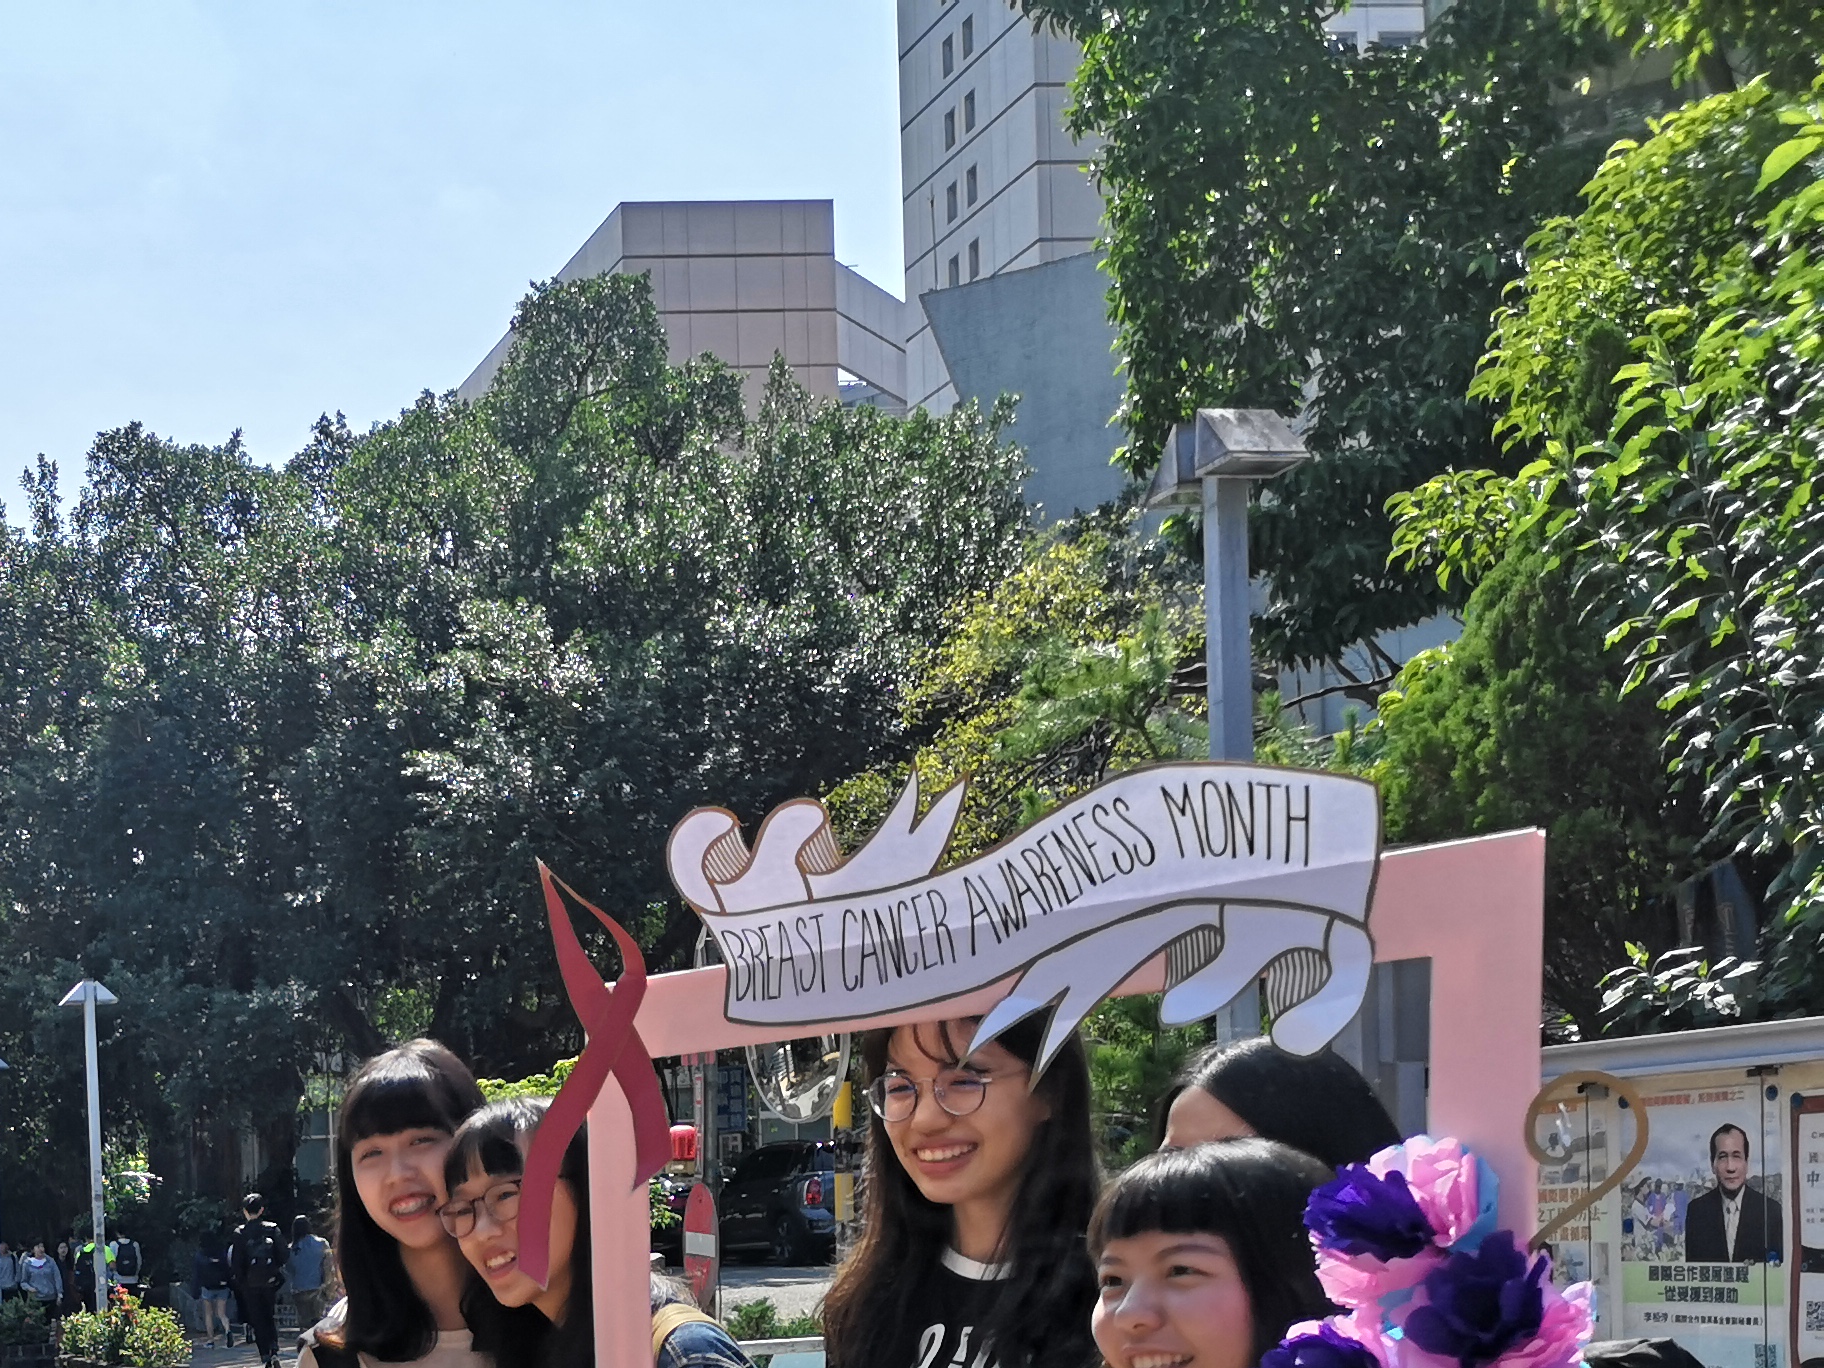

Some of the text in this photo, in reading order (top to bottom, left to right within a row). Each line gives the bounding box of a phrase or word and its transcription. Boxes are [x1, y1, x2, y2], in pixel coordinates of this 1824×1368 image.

[721, 779, 1311, 1002] BREAST CANCER AWARENESS MONTH
